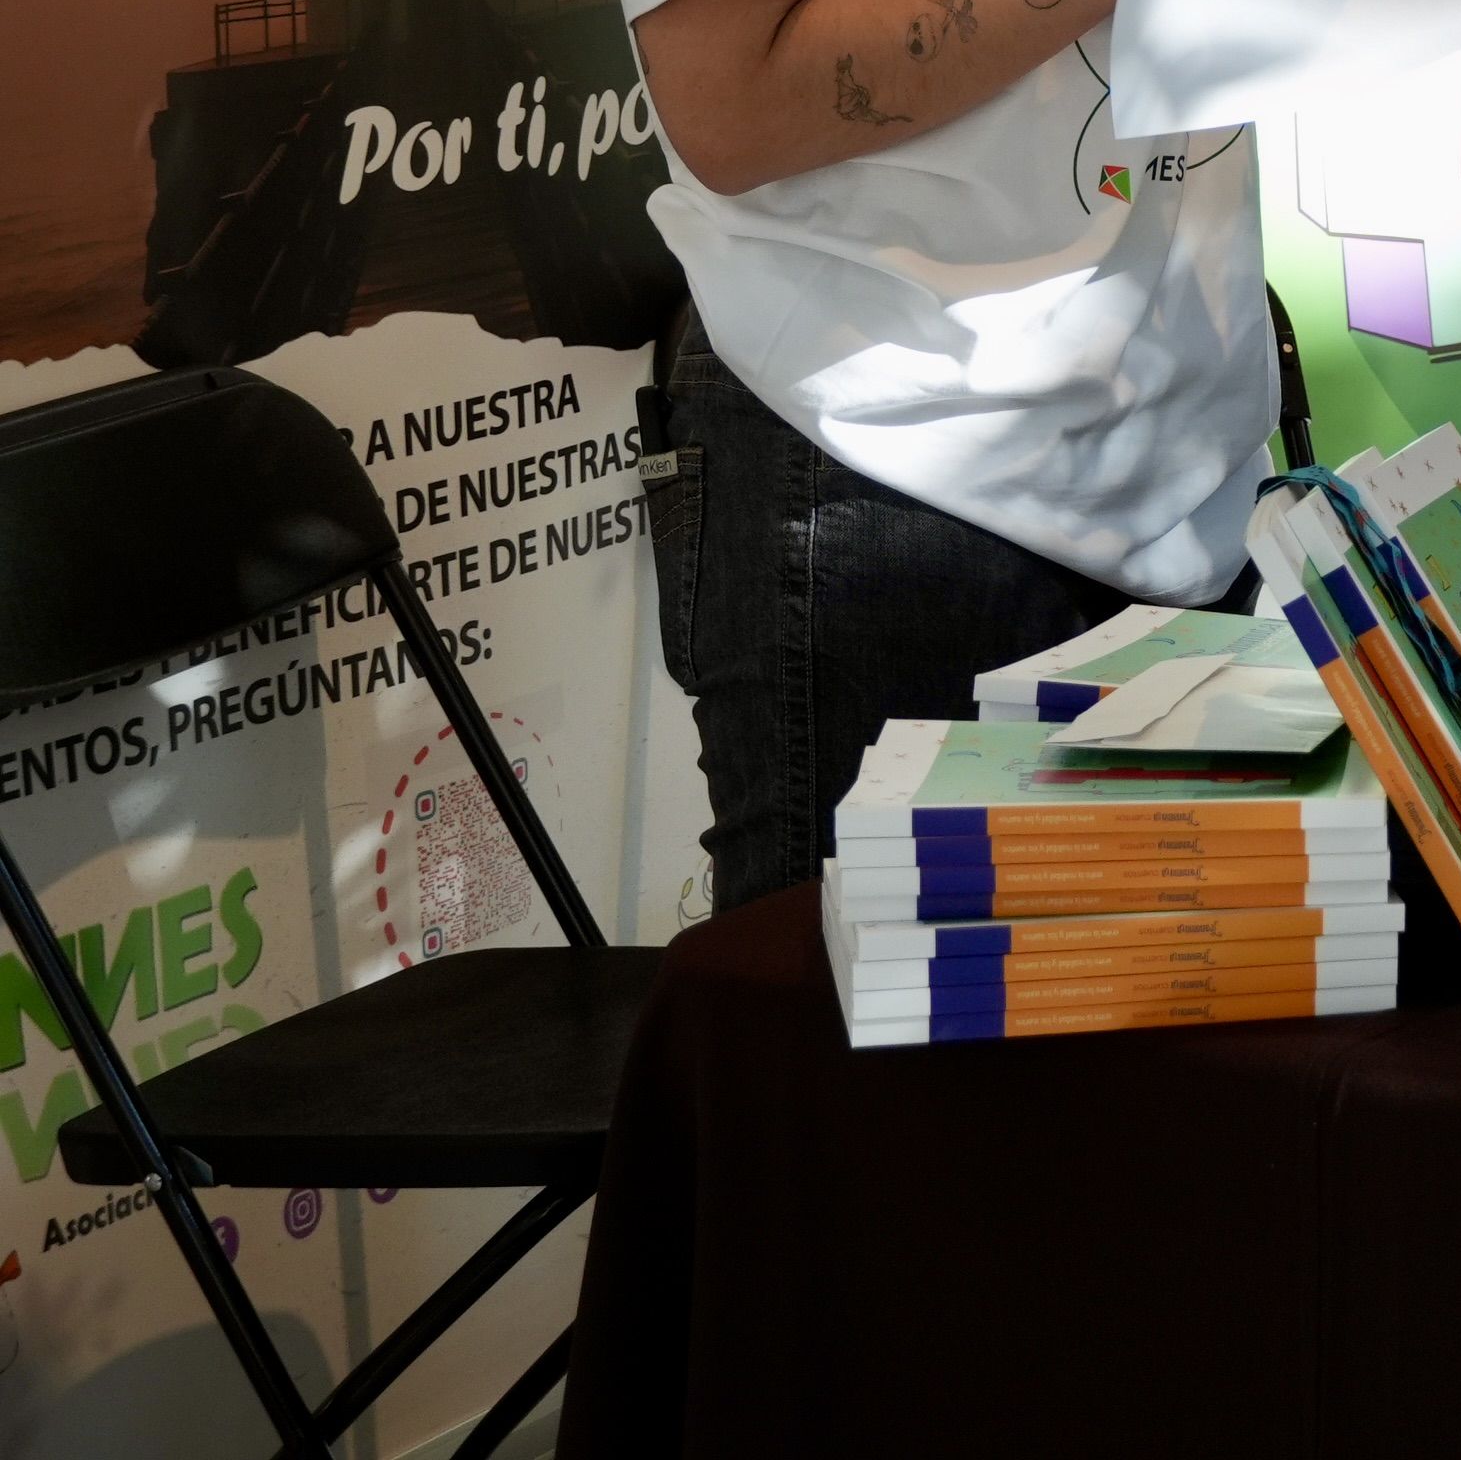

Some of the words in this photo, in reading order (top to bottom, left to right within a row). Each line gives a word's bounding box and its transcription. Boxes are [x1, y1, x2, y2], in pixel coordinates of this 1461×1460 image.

[339, 104, 472, 205] Por
[497, 76, 564, 177] ti,
[365, 419, 395, 466] A
[404, 372, 581, 458] NUESTRA
[396, 478, 451, 534] DE
[459, 426, 642, 518] NUESTRAS
[489, 529, 539, 585] DE
[546, 495, 650, 567] NUEST
[43, 1184, 159, 1253] Asociac
